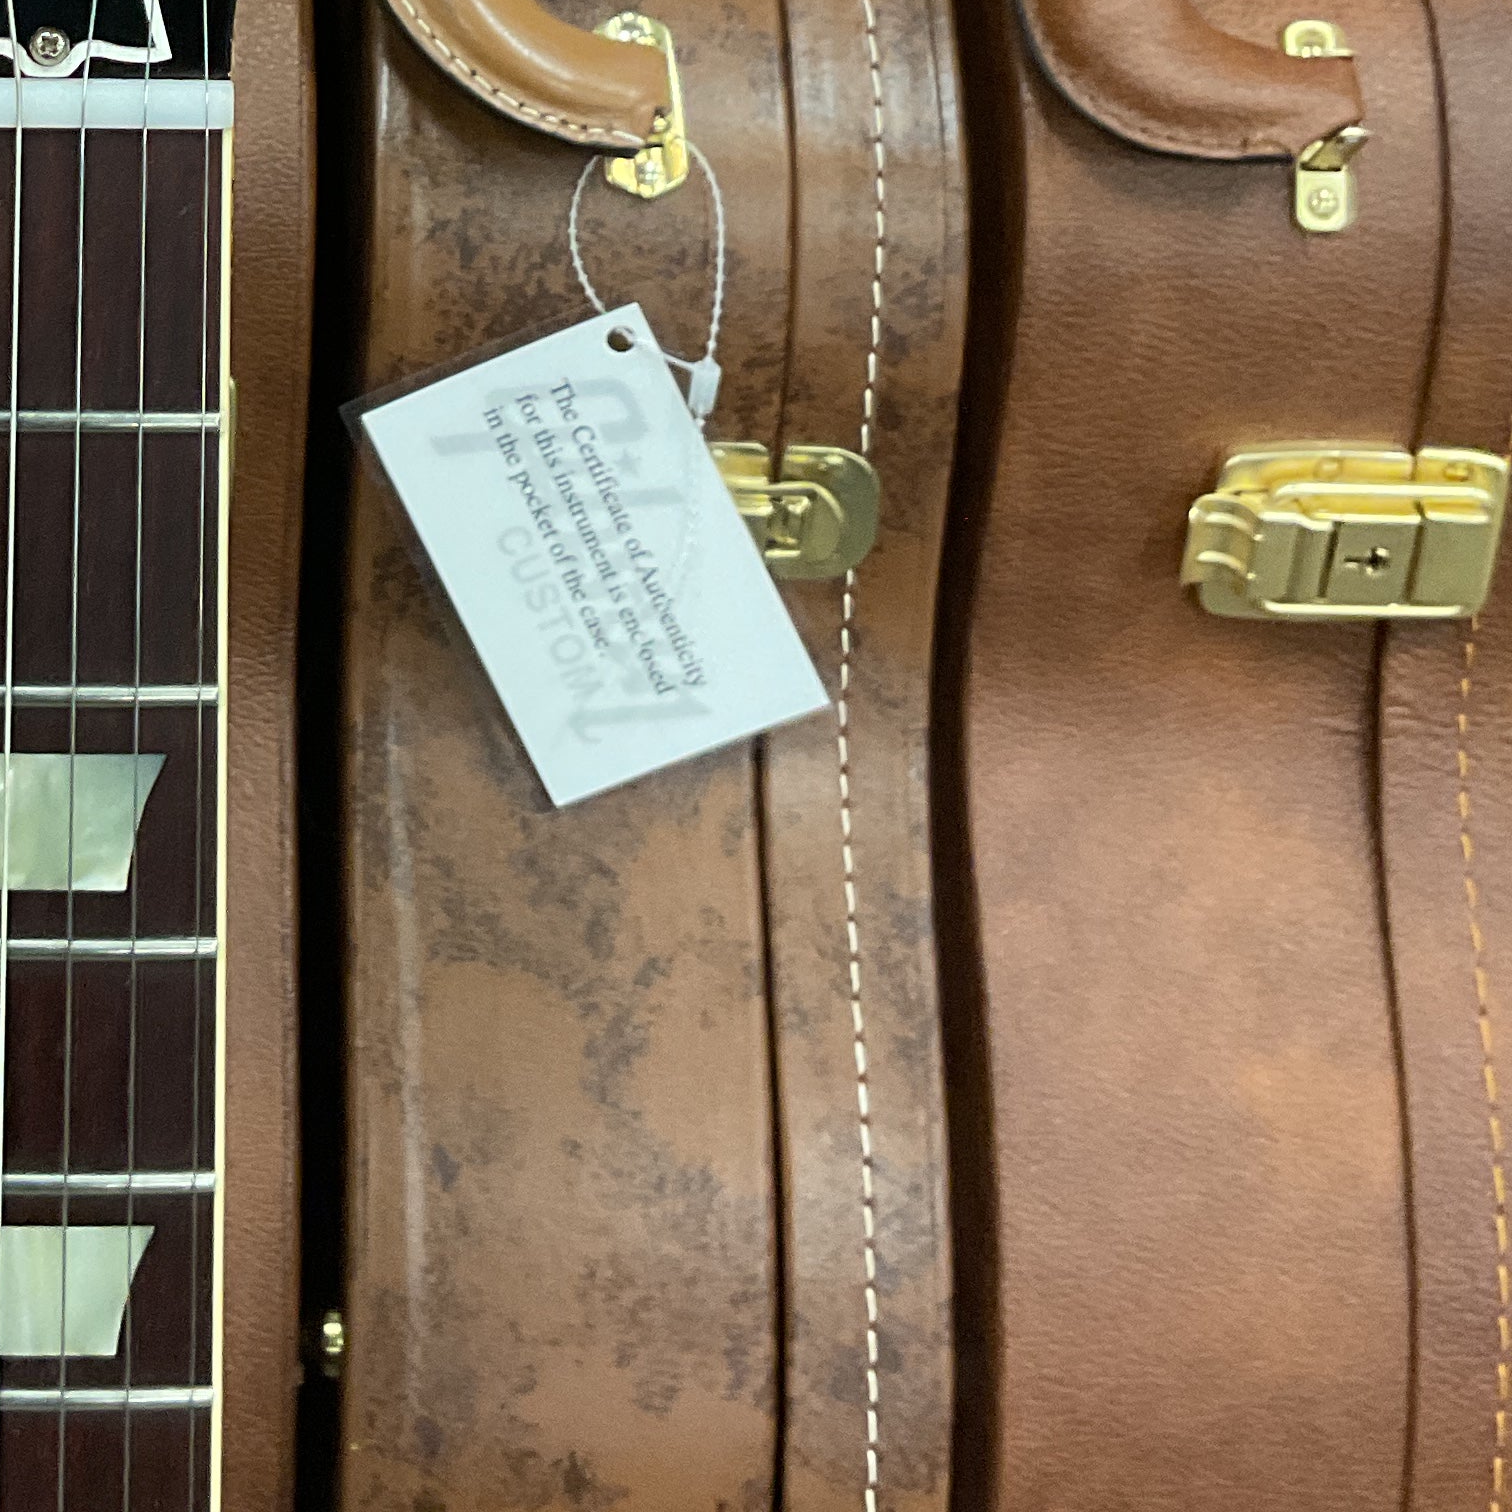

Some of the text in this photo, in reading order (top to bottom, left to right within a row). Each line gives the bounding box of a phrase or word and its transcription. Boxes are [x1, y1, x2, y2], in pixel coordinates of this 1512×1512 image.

[481, 404, 504, 430] in
[494, 431, 521, 466] the
[505, 469, 559, 539] pocket
[513, 392, 677, 695] for this instrument is enclosed
[547, 376, 707, 687] The Certificate of Authenticity
[548, 541, 578, 565] of
[560, 567, 587, 600] the
[497, 524, 605, 701] CUSTOM
